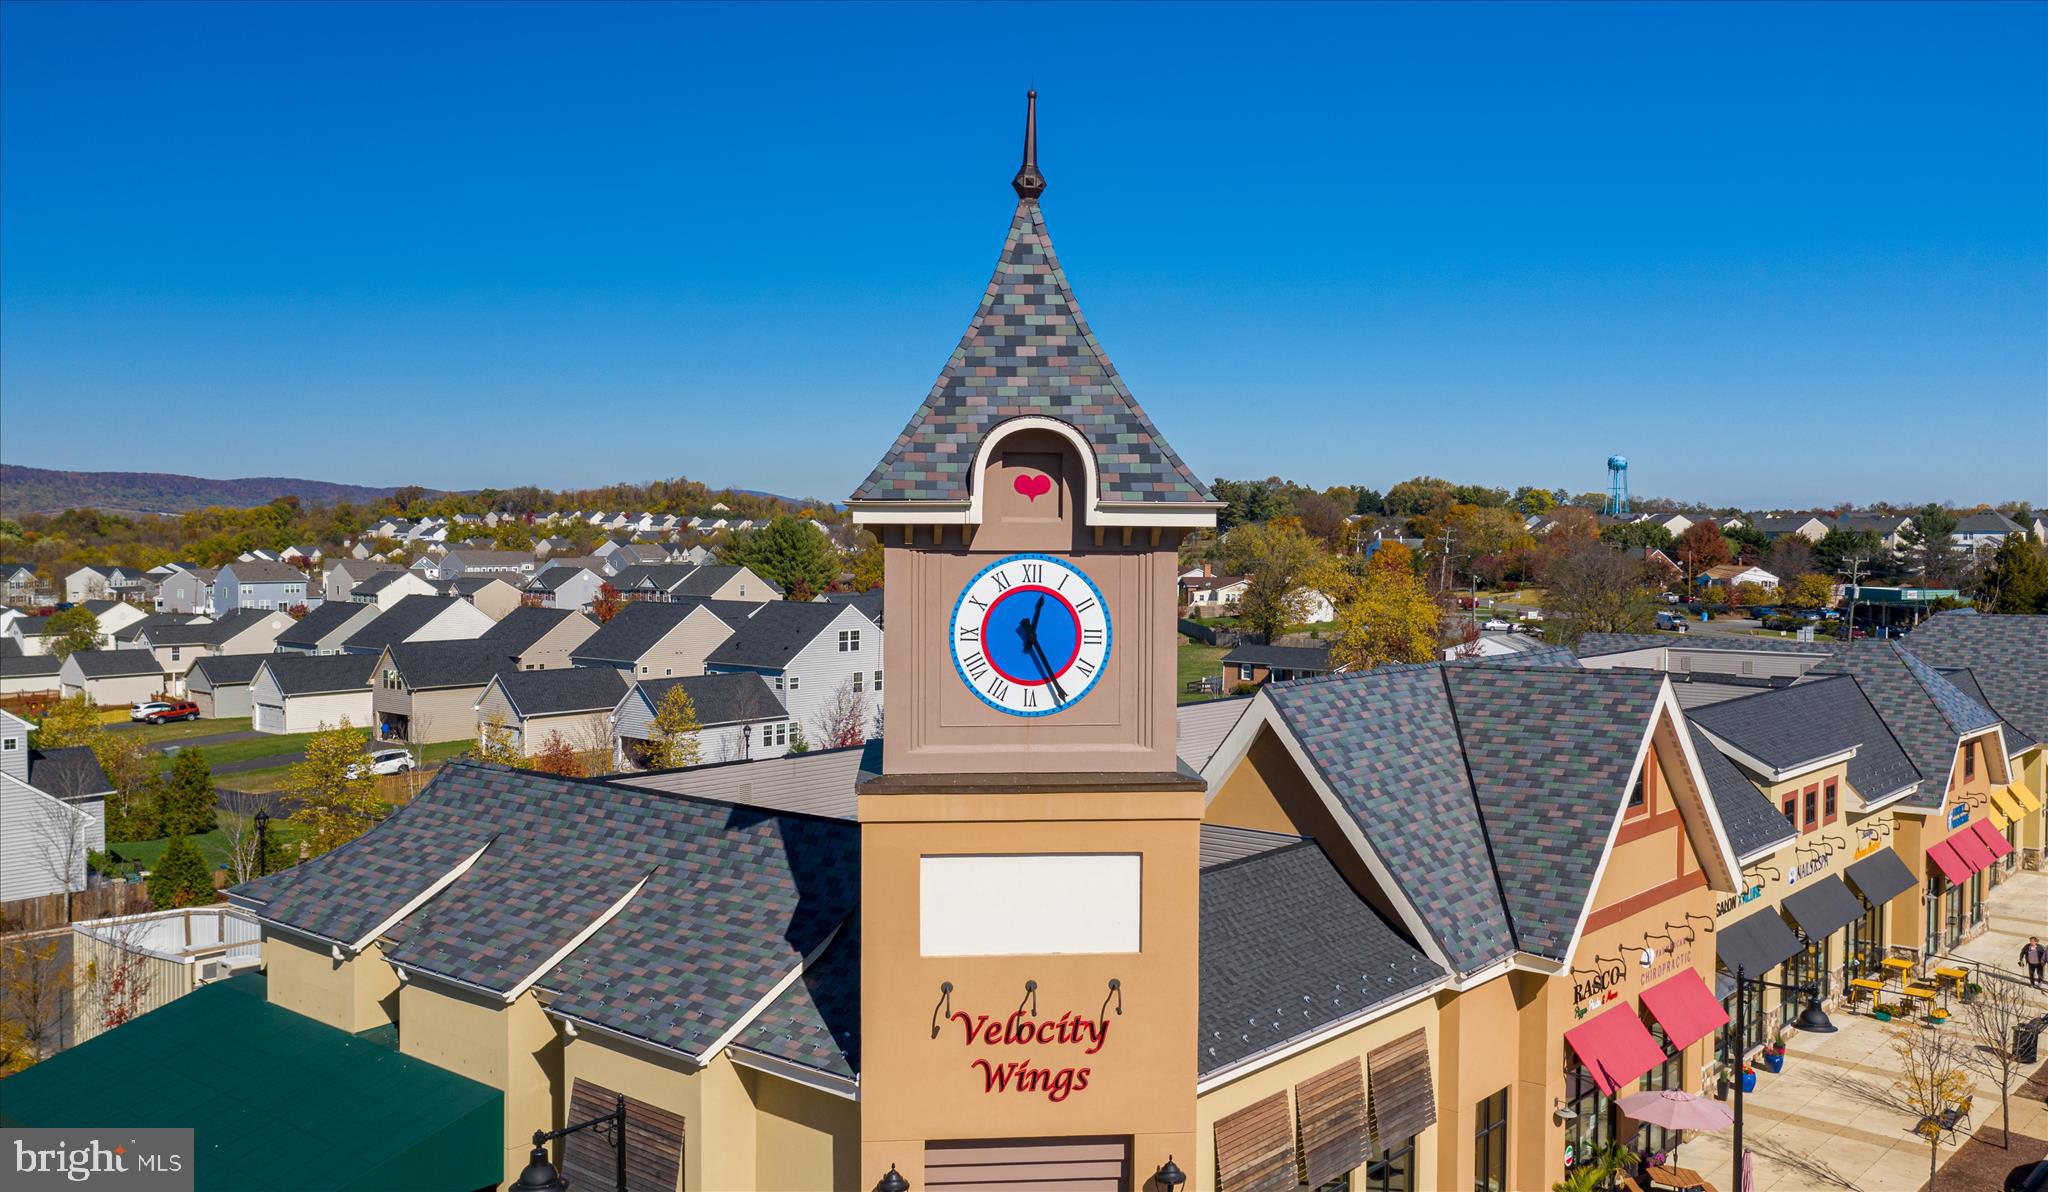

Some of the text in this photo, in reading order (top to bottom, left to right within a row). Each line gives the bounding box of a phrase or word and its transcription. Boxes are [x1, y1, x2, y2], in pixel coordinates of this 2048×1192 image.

[991, 570, 1012, 593] XI
[1022, 564, 1043, 583] XII
[1057, 573, 1070, 591] I
[968, 595, 989, 612] X
[1075, 597, 1096, 614] II
[1084, 628, 1103, 645] III
[963, 651, 990, 682] VIII
[1075, 657, 1096, 679] IV
[986, 677, 1010, 702] VII
[1716, 895, 1737, 917] SALON
[1640, 950, 1692, 986] CHIROPRACTIC
[1573, 966, 1620, 1005] RASCO
[950, 1010, 1110, 1055] Velocity
[970, 1057, 1092, 1103] Wings
